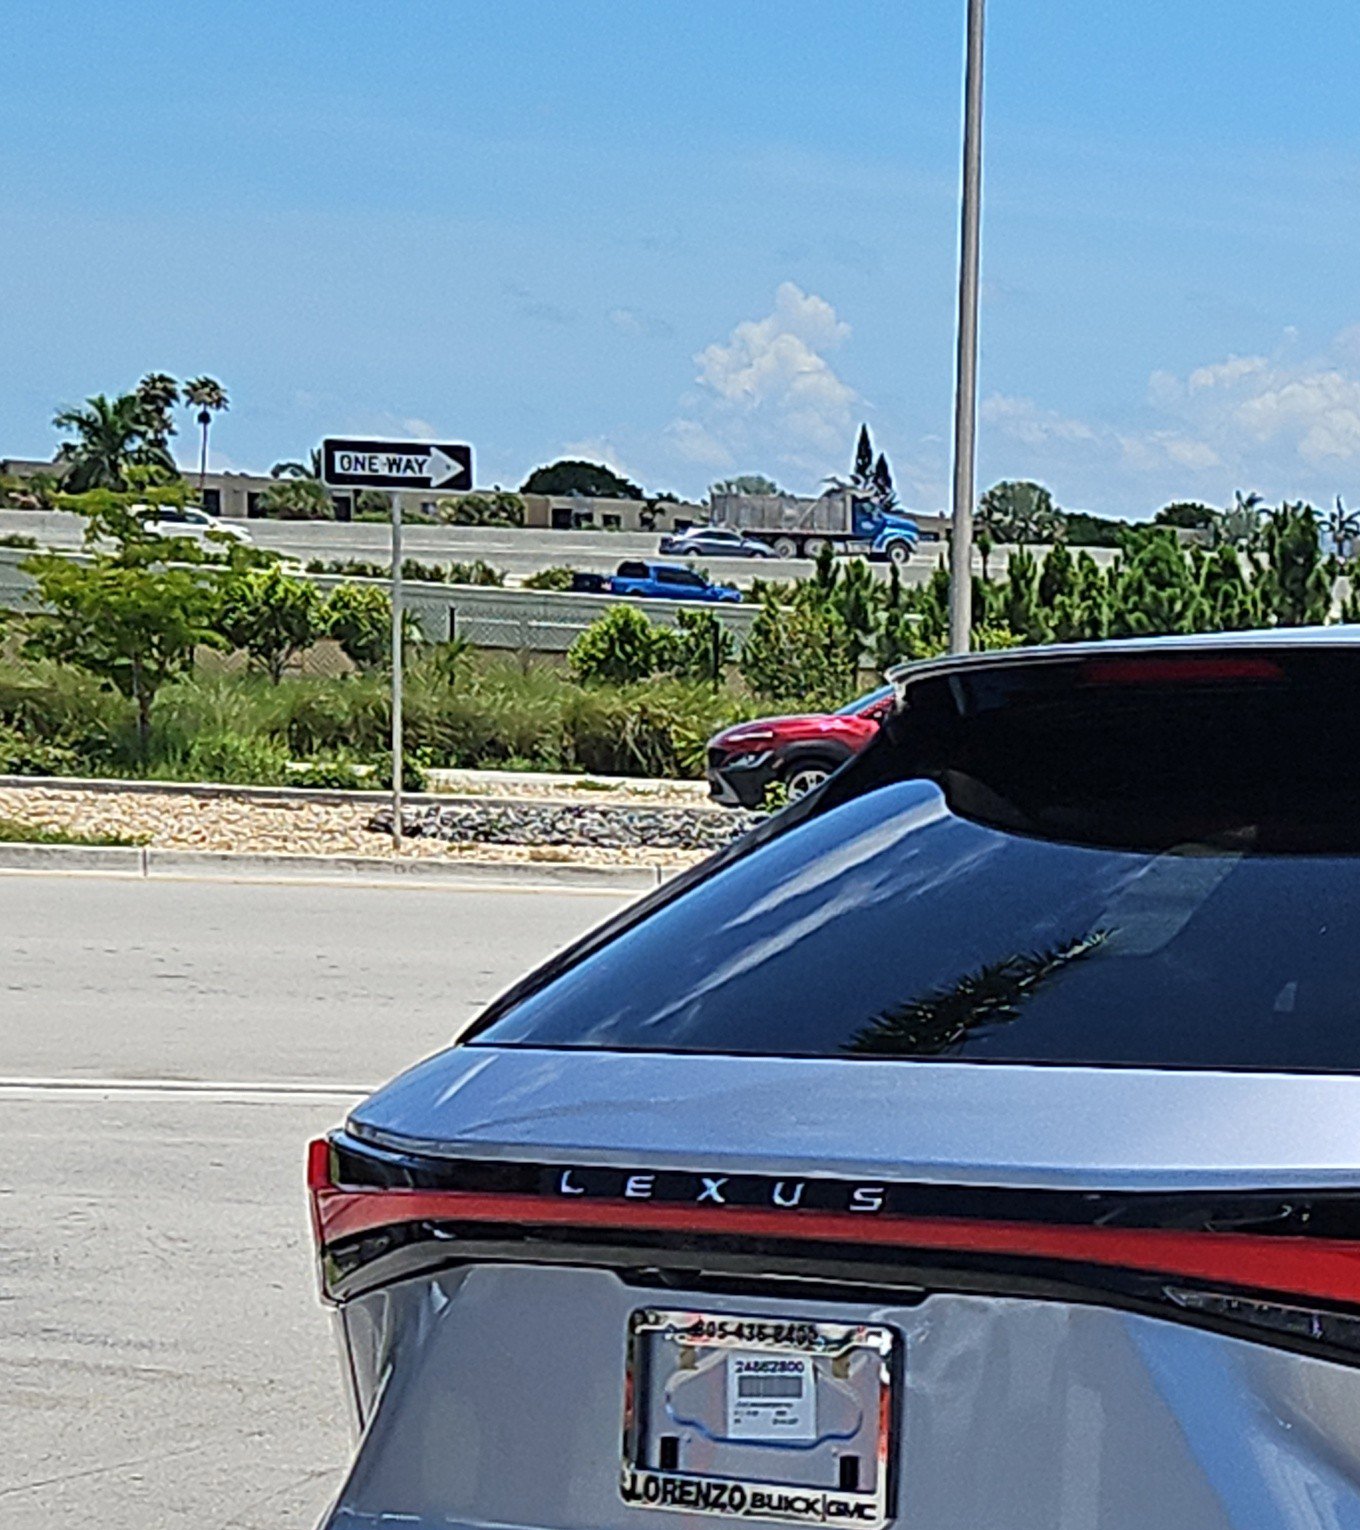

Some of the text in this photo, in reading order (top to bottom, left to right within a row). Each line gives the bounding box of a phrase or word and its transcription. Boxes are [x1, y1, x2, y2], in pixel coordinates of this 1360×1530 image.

[339, 453, 428, 476] ONE WAY
[560, 1169, 884, 1211] LEXUS
[750, 1490, 822, 1517] BUICK
